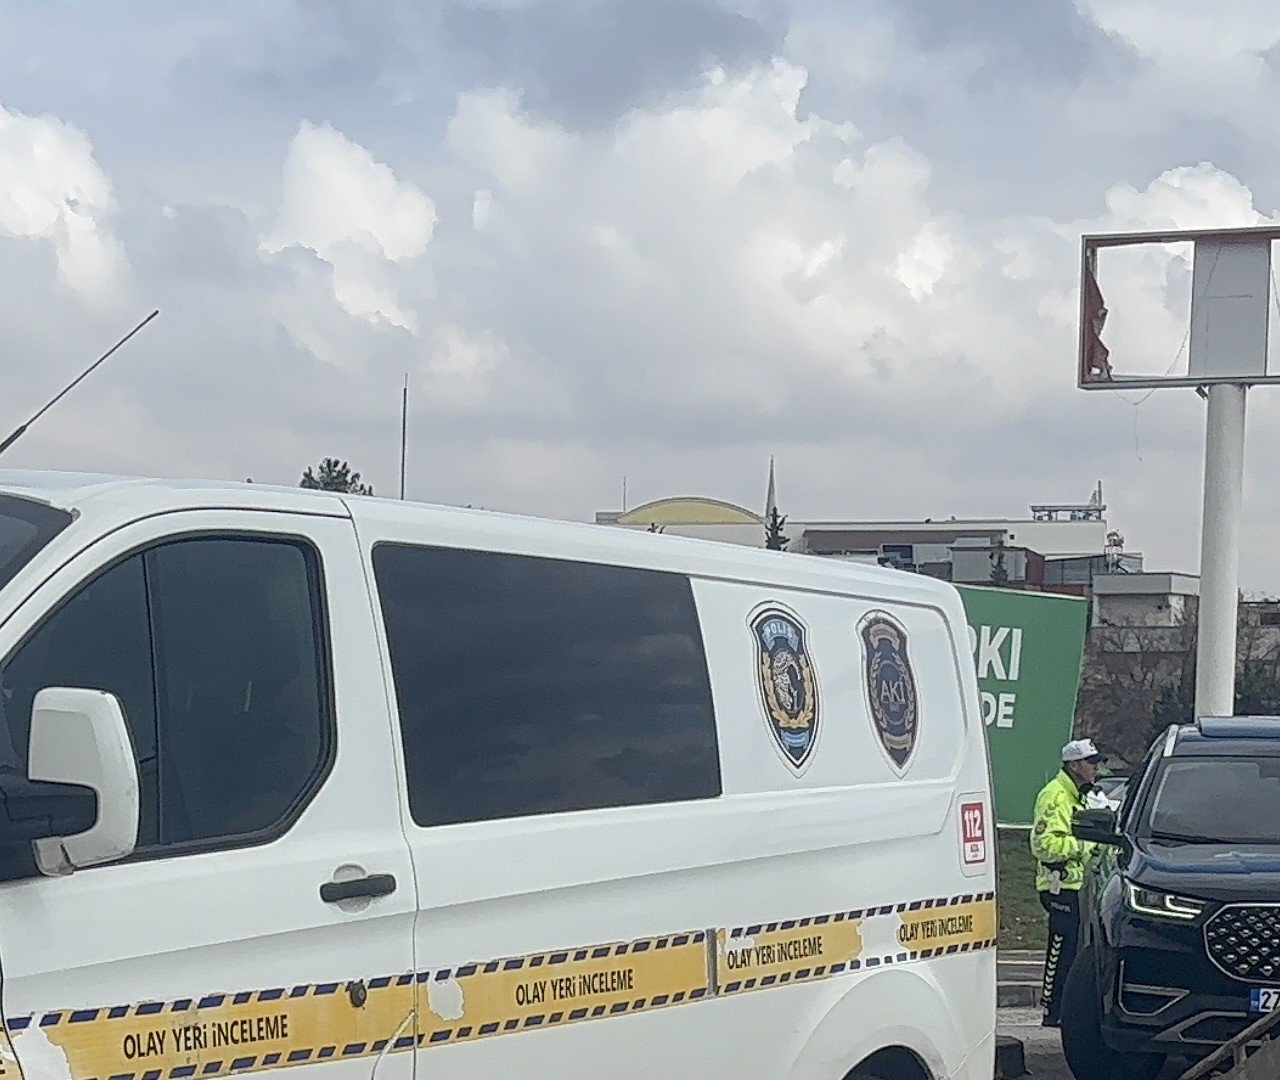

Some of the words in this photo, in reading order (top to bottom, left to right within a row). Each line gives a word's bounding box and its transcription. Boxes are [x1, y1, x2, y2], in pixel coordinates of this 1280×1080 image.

[964, 808, 983, 838] 112
[727, 948, 753, 969] OLAY
[515, 979, 547, 1006] OLAY
[123, 1029, 167, 1060] OLAY
